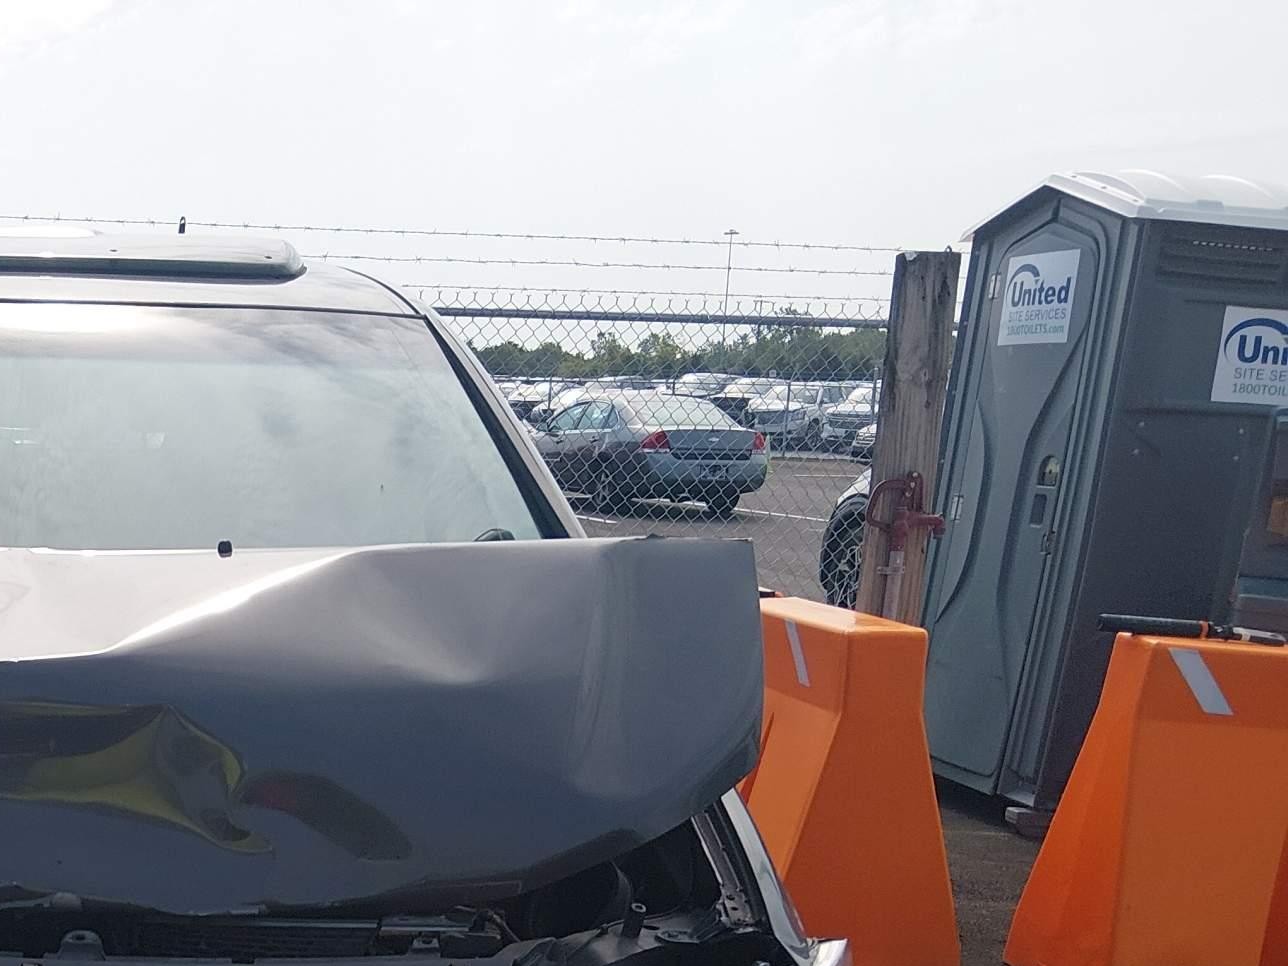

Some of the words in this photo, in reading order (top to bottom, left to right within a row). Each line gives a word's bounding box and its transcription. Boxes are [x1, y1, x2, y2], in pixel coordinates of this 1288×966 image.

[1011, 276, 1072, 307] United
[1024, 308, 1067, 321] SERVICES
[1233, 367, 1265, 381] SITE
[1269, 369, 1288, 382] SE
